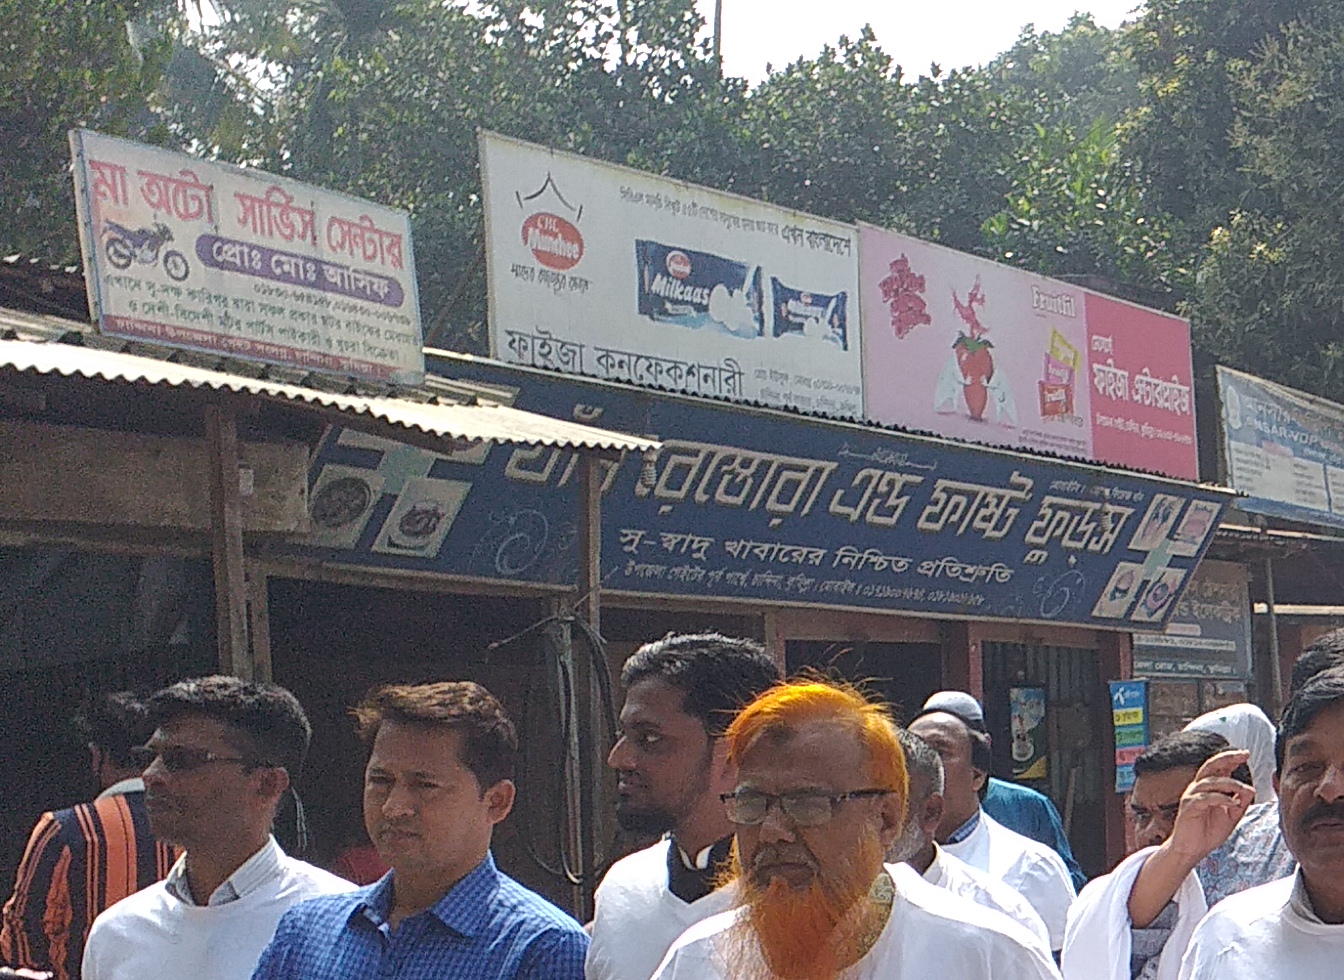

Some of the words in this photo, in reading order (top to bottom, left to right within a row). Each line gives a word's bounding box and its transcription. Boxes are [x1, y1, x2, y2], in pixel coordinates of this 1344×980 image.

[89, 158, 128, 207] মা
[137, 168, 214, 224] অটো
[234, 186, 318, 247] সার্ভিস
[326, 213, 405, 271] সেন্টার
[271, 253, 317, 281] মোঃ
[323, 261, 391, 301] আসিফ
[650, 272, 711, 306] Milkaas
[505, 325, 587, 377] ফাইজা
[594, 347, 747, 398] কনফেকশনারী
[1092, 358, 1130, 403] ফাইজা
[1132, 367, 1191, 417] এন্টারপ্রাইজ
[620, 528, 715, 561] সু-স্বাদু
[724, 540, 828, 568] খাবারের
[832, 545, 914, 574] নিশ্চিত
[916, 555, 1015, 584] প্রতিশ্রুতি
